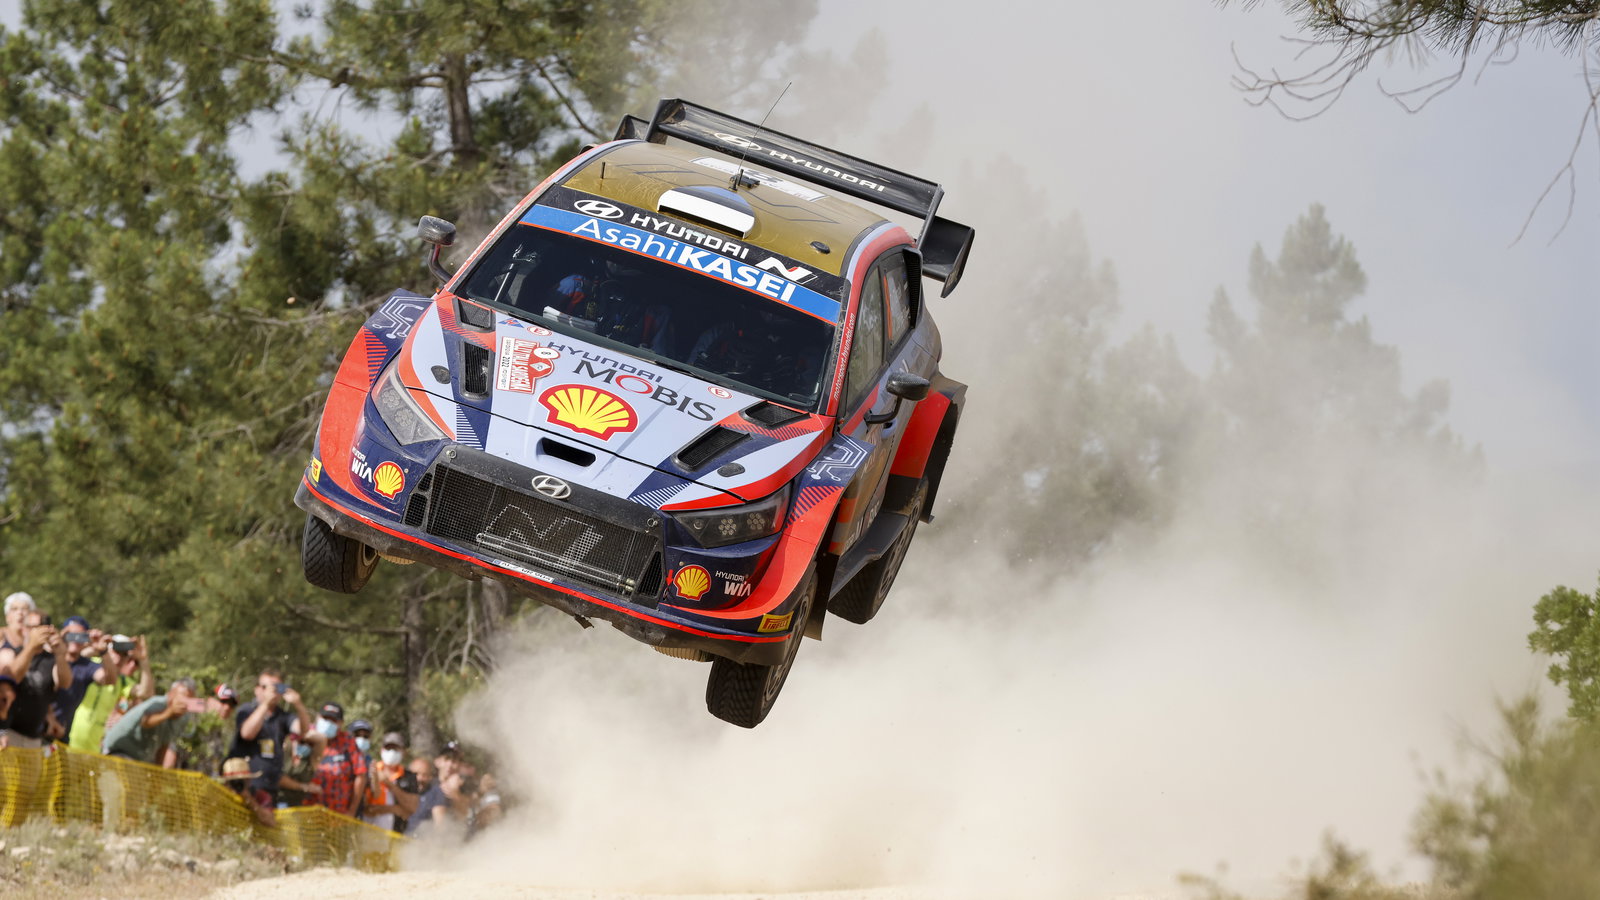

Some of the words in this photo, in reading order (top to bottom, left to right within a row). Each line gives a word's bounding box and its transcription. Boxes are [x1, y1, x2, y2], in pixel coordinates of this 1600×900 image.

[770, 150, 885, 192] HYUNDAI
[572, 218, 796, 302] AsahiKASEI
[630, 212, 749, 260] HYUNDAI
[547, 342, 663, 383] HYUNDAI
[834, 313, 856, 400] motorsport.hyundai.com
[573, 360, 716, 421] MOBIS
[715, 570, 744, 582] HYUNDAI
